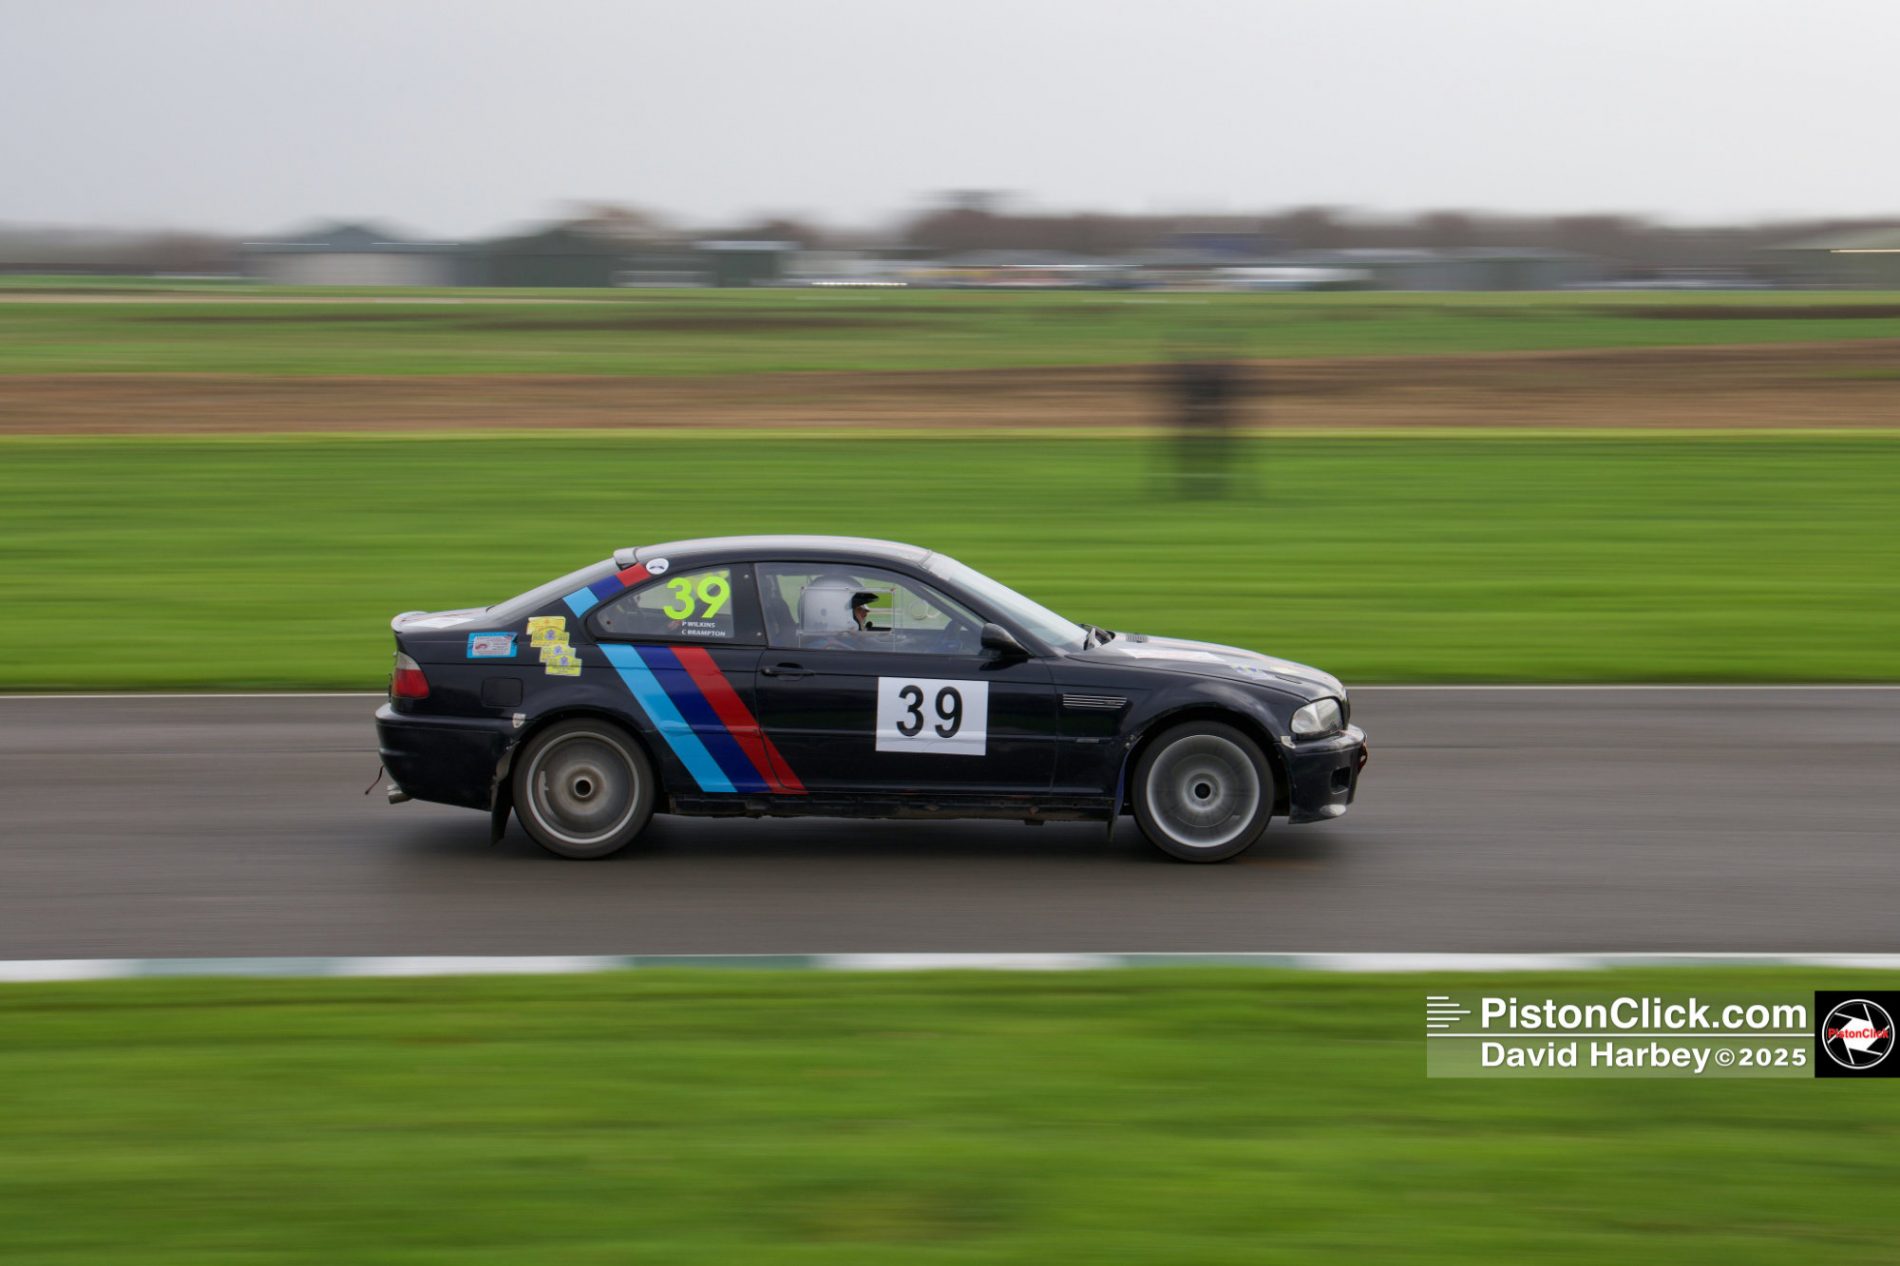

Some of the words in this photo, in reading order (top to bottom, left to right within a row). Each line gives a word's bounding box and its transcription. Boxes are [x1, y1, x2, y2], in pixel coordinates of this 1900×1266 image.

[664, 576, 731, 620] 39
[687, 629, 726, 637] BRAMPTON
[896, 684, 963, 738] 39
